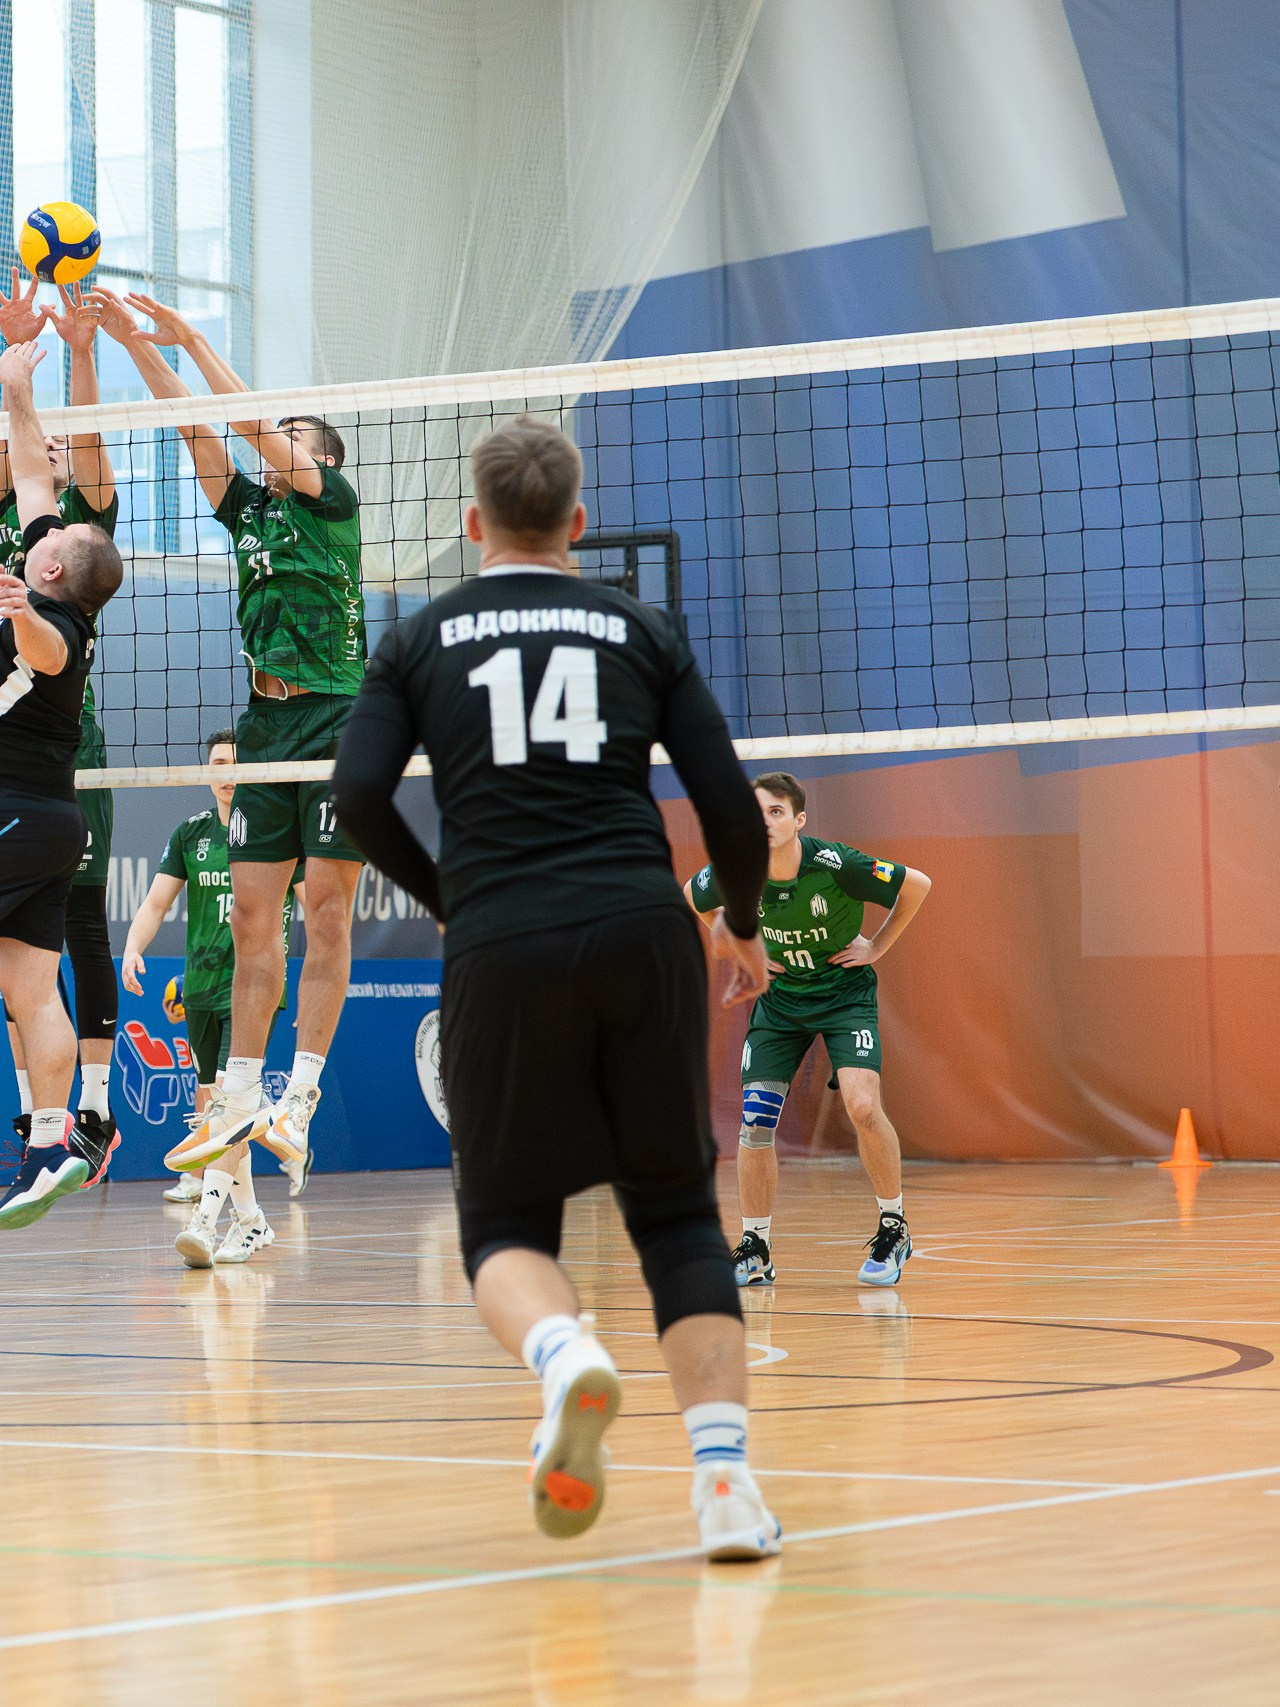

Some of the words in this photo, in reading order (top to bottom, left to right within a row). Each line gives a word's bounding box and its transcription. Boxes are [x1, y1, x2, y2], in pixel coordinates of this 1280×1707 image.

[440, 608, 627, 647] ЕВДОКИМОВ
[468, 645, 607, 766] 14
[762, 925, 828, 945] МОСТ-11
[783, 950, 815, 970] 10
[851, 1029, 874, 1050] 10
